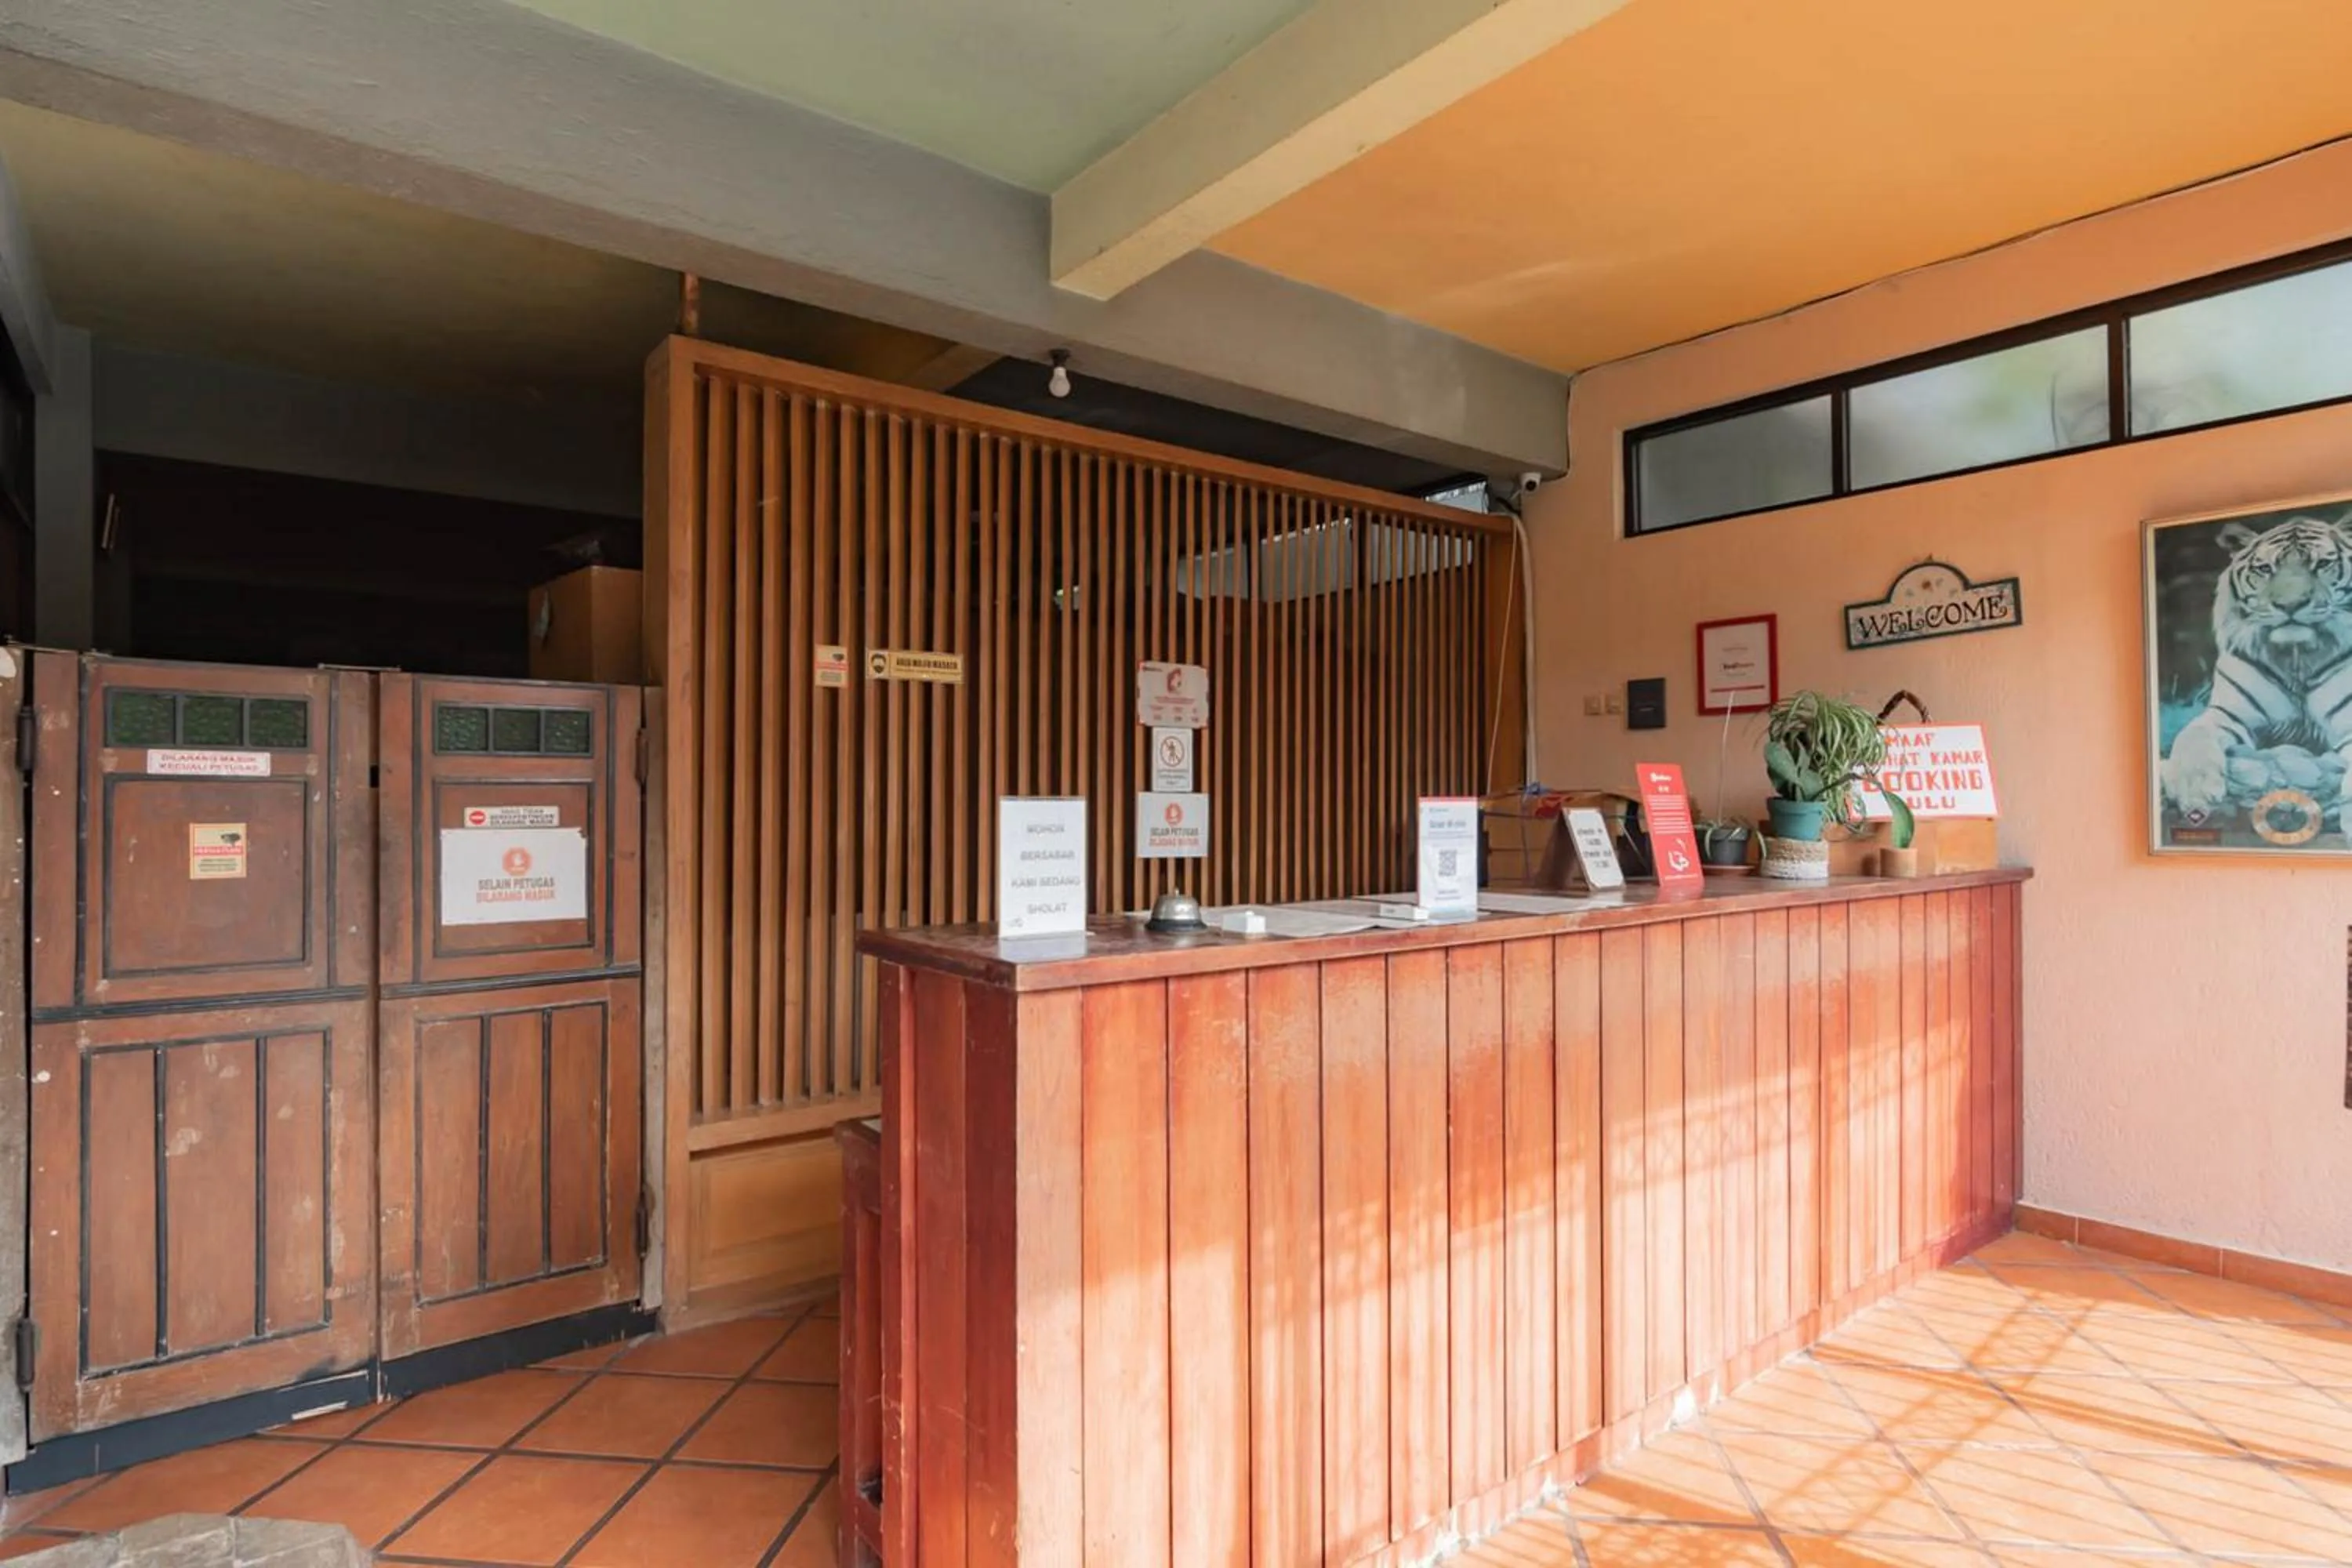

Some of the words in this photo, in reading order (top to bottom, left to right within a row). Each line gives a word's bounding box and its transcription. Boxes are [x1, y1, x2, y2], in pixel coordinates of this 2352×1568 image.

[1857, 592, 2009, 639] WELCOME
[1885, 733, 1934, 747] MAAF
[162, 753, 217, 762] DILARANG
[1930, 750, 1984, 765] KAMAR
[1906, 796, 1955, 810] ULU
[1026, 824, 1065, 833] MOHON
[1020, 850, 1076, 861] BERSABAR
[477, 878, 511, 891] SELAIN
[514, 877, 556, 889] PETUGAS
[1011, 877, 1037, 887] KAMI
[1039, 876, 1080, 887] SEDANG
[1027, 902, 1068, 914] SHOLAT
